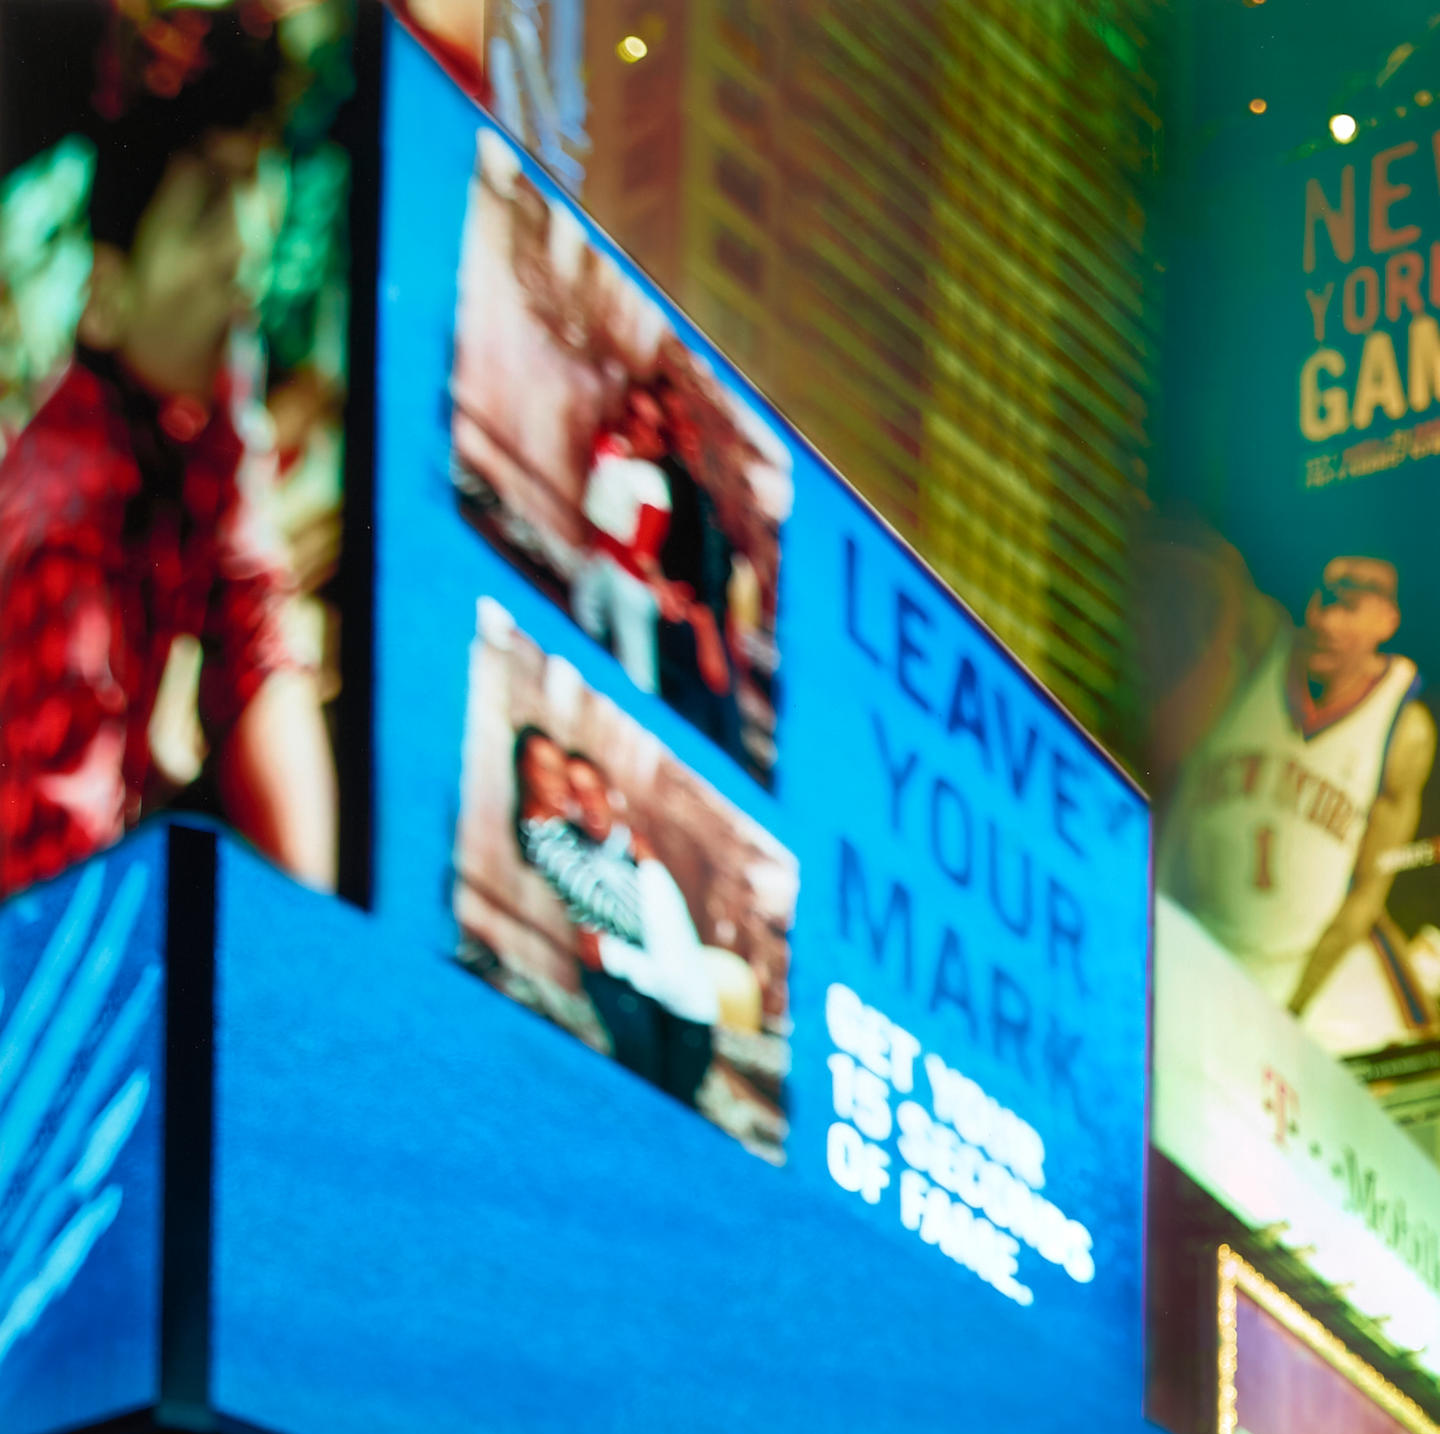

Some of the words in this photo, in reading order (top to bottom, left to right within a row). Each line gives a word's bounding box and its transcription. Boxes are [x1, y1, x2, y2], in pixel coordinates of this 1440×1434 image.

[844, 532, 1088, 855] LEAVE
[838, 835, 1088, 1107] MARK
[872, 708, 1090, 1000] YOUR
[830, 1055, 893, 1140] 15
